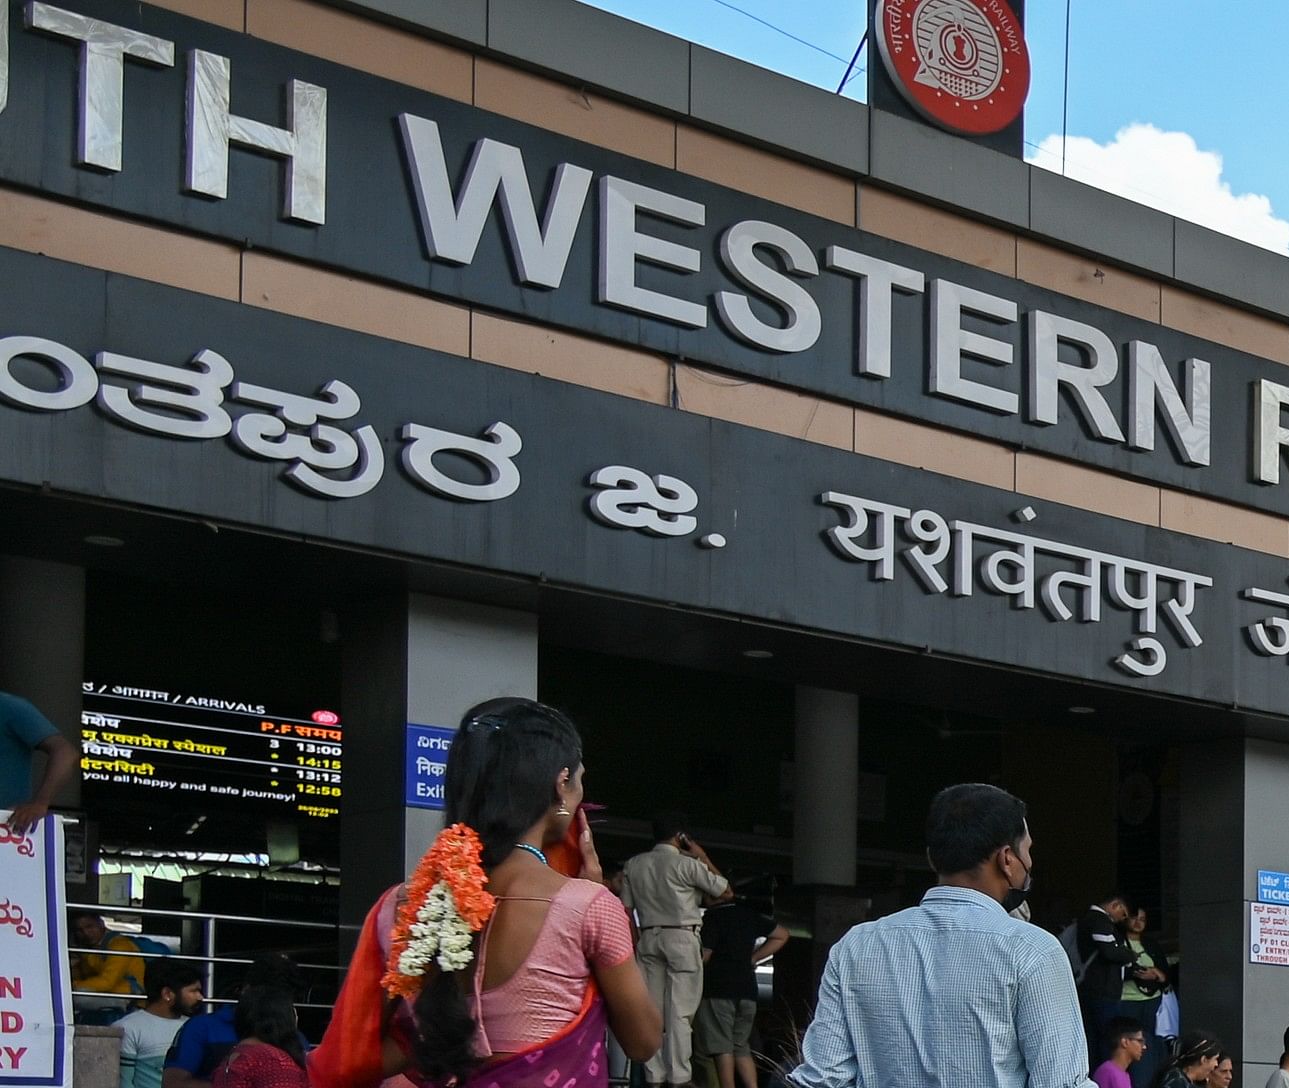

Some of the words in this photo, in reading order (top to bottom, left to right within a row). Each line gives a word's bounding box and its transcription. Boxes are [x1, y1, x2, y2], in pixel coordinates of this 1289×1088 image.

[988, 2, 1021, 56] RAILWAY
[0, 0, 327, 225] TH
[399, 112, 1211, 467] WESTERN
[822, 491, 1214, 677] यशवंतपुर
[112, 685, 169, 702] आगमन
[185, 696, 266, 715] ARRIVALS
[261, 721, 292, 734] P.F
[295, 724, 342, 741] समय
[172, 739, 227, 757] स्पेशल
[269, 739, 280, 749] 3
[296, 742, 342, 757] 13:00
[296, 756, 342, 770] 14:15
[296, 770, 342, 784] 13:12
[83, 772, 110, 782] you
[113, 773, 130, 784] all
[133, 775, 177, 791] happy
[180, 781, 207, 792] and
[209, 784, 240, 796] safe
[242, 786, 296, 802] journey!
[296, 783, 342, 797] 12:58
[1256, 954, 1288, 964] THROUGH
